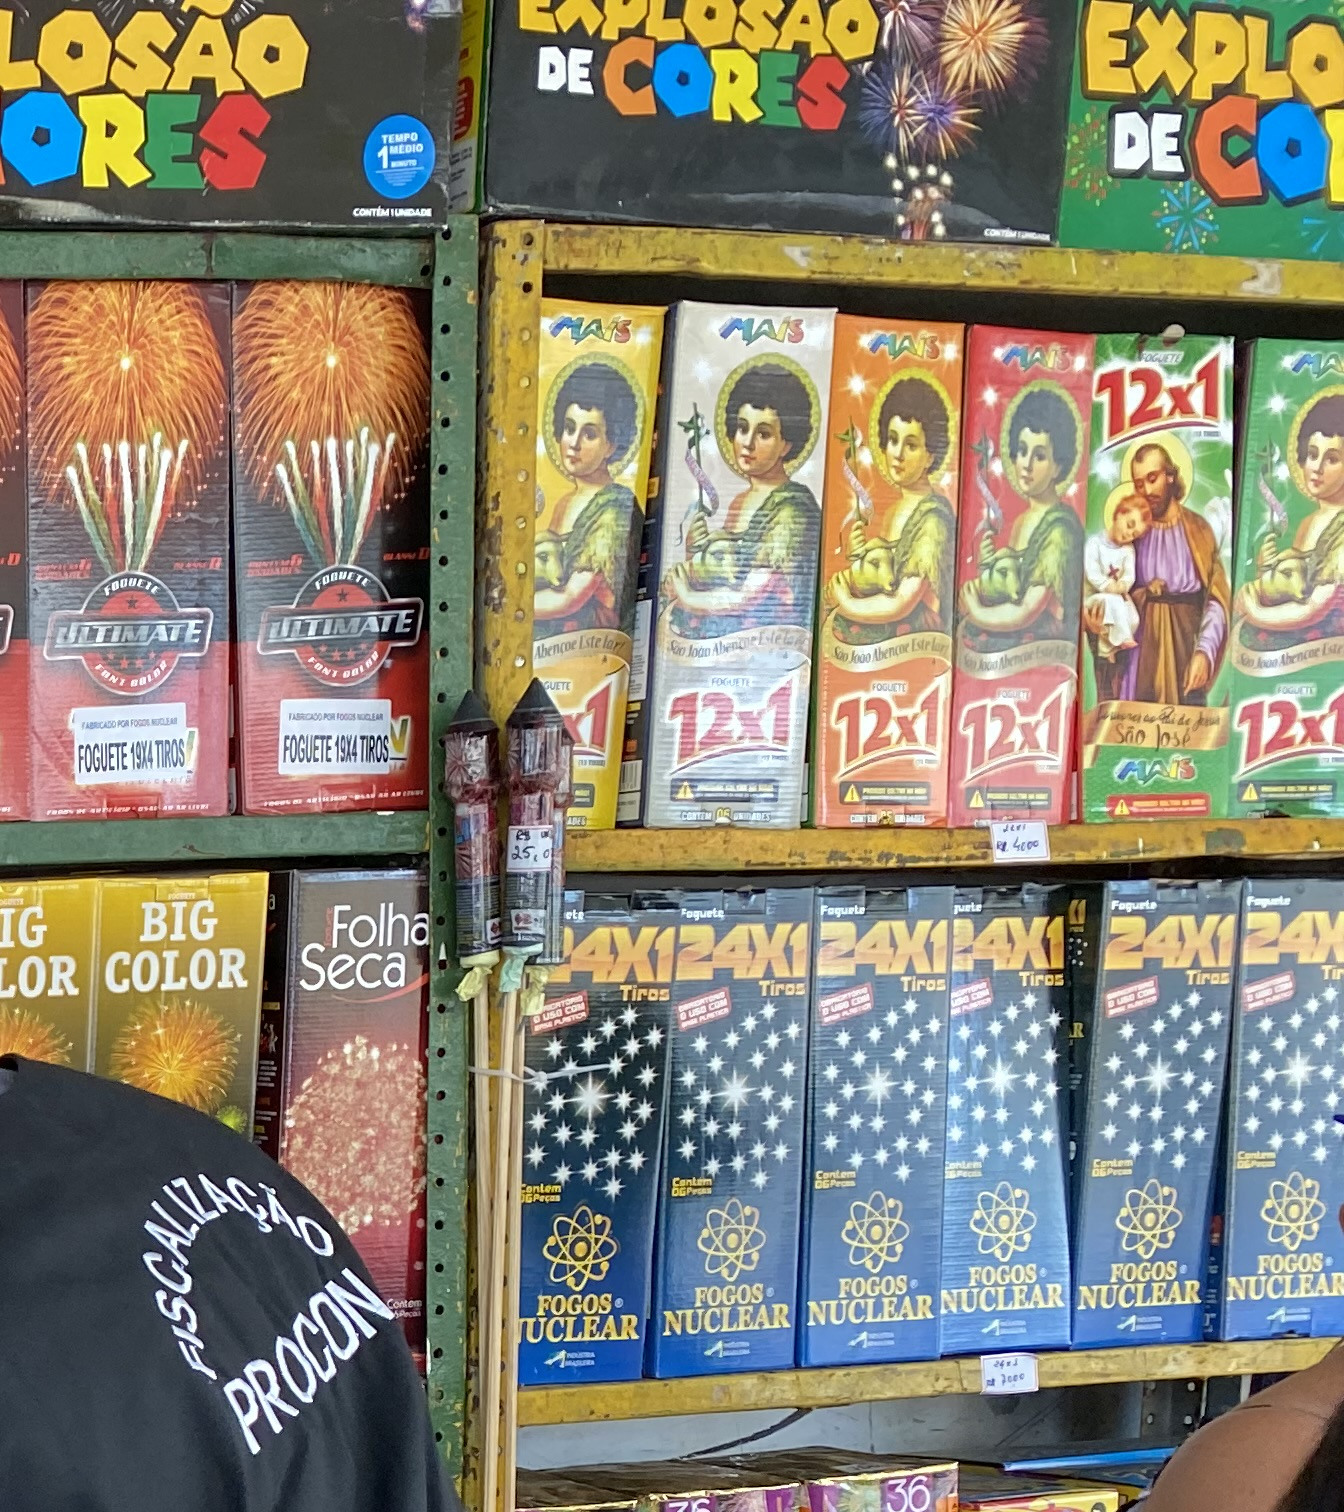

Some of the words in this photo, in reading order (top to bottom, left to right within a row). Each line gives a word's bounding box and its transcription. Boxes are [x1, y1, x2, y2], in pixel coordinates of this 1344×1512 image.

[537, 46, 595, 96] DE
[603, 37, 850, 131] CORES
[377, 147, 388, 169] 1
[390, 141, 424, 156] MÉDIO
[381, 133, 418, 146] TEMPO
[1114, 111, 1186, 173] DE
[395, 207, 432, 219] UNIDADE
[1094, 350, 1226, 442] 12x1
[56, 621, 203, 646] ULTIMATE
[267, 610, 413, 641] ULTIMATE
[77, 741, 129, 773] FOGUETE
[130, 739, 152, 771] 19X4
[155, 738, 186, 767] TIROS
[282, 733, 333, 764] FOGUETE
[334, 733, 357, 762] 19X4
[360, 733, 389, 762] TIROS
[139, 900, 219, 941] BIG
[331, 902, 429, 948] Folha
[820, 903, 866, 916] Foguete
[675, 921, 810, 981] 24X1
[817, 919, 949, 976] 24X1
[1104, 913, 1237, 970] 24X1
[104, 948, 248, 992] COLOR
[299, 942, 408, 992] Seca
[759, 981, 806, 997] Tiros
[900, 975, 946, 993] Tiros
[142, 1172, 335, 1381] FISCALIZAÇÃO
[838, 1276, 908, 1298] FOGOS
[1111, 1262, 1178, 1283] FOGOS
[694, 1283, 764, 1306] FOGOS
[1077, 1281, 1202, 1311] NUCLEAR
[663, 1304, 791, 1338] NUCLEAR
[807, 1295, 934, 1328] NUCLEAR
[223, 1267, 395, 1455] PROCON
